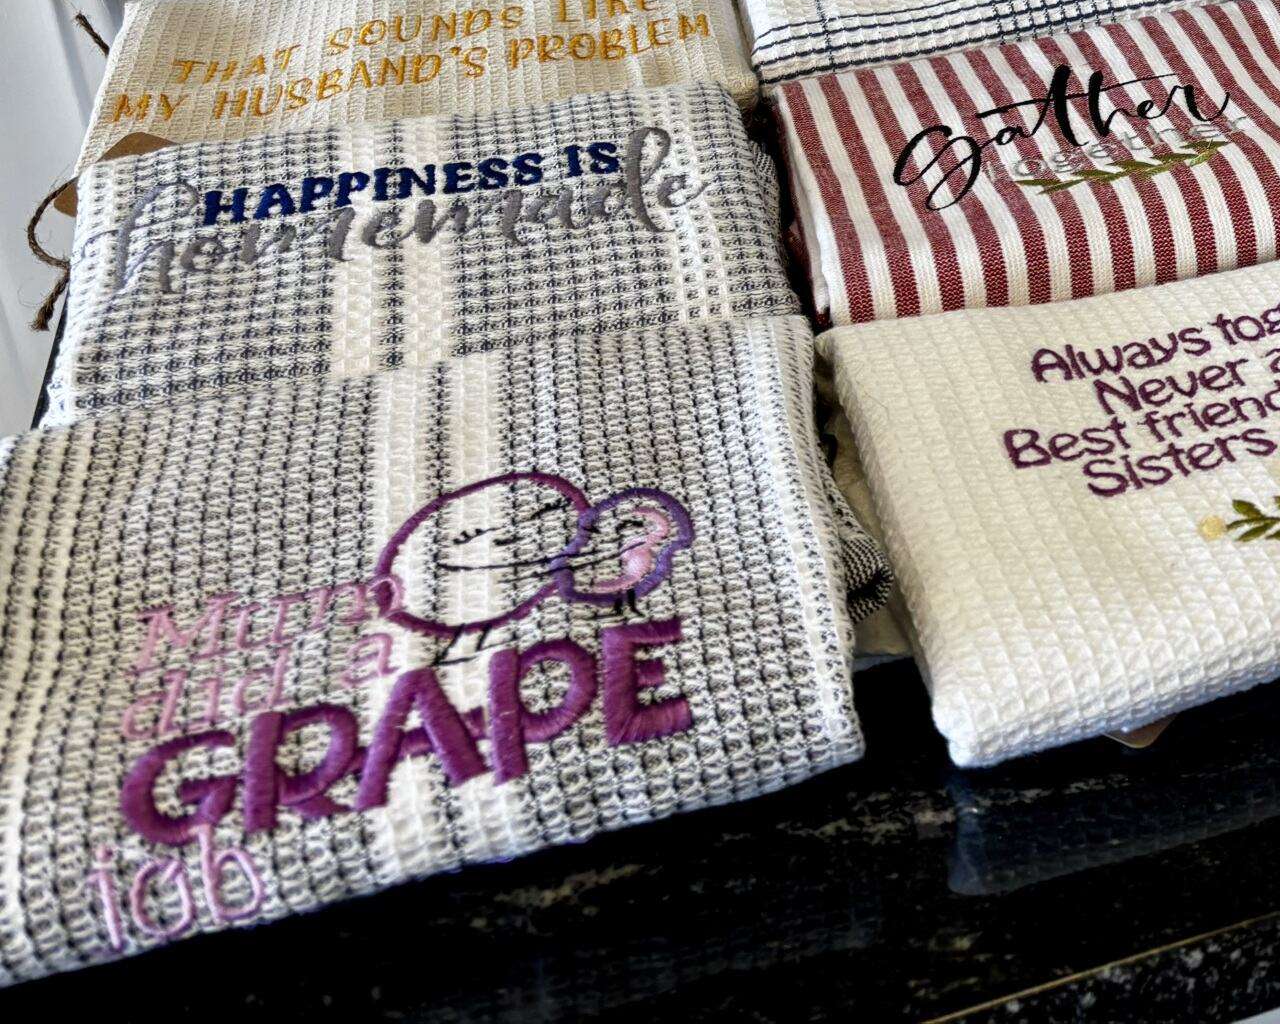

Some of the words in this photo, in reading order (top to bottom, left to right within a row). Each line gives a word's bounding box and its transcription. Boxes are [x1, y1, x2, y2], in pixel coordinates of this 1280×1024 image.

[110, 92, 189, 123] MY
[213, 45, 489, 119] HUSBAND'S
[508, 10, 711, 70] PROBLEM
[171, 44, 301, 85] THAT
[326, 5, 525, 57] SOUNDS
[202, 152, 544, 226] HAPPINESS
[563, 141, 620, 177] IS
[1030, 327, 1211, 383] Always
[1093, 358, 1248, 415] Never
[1003, 416, 1131, 468] Best
[1082, 428, 1278, 497] Sisters
[120, 616, 693, 845] GRAPE
